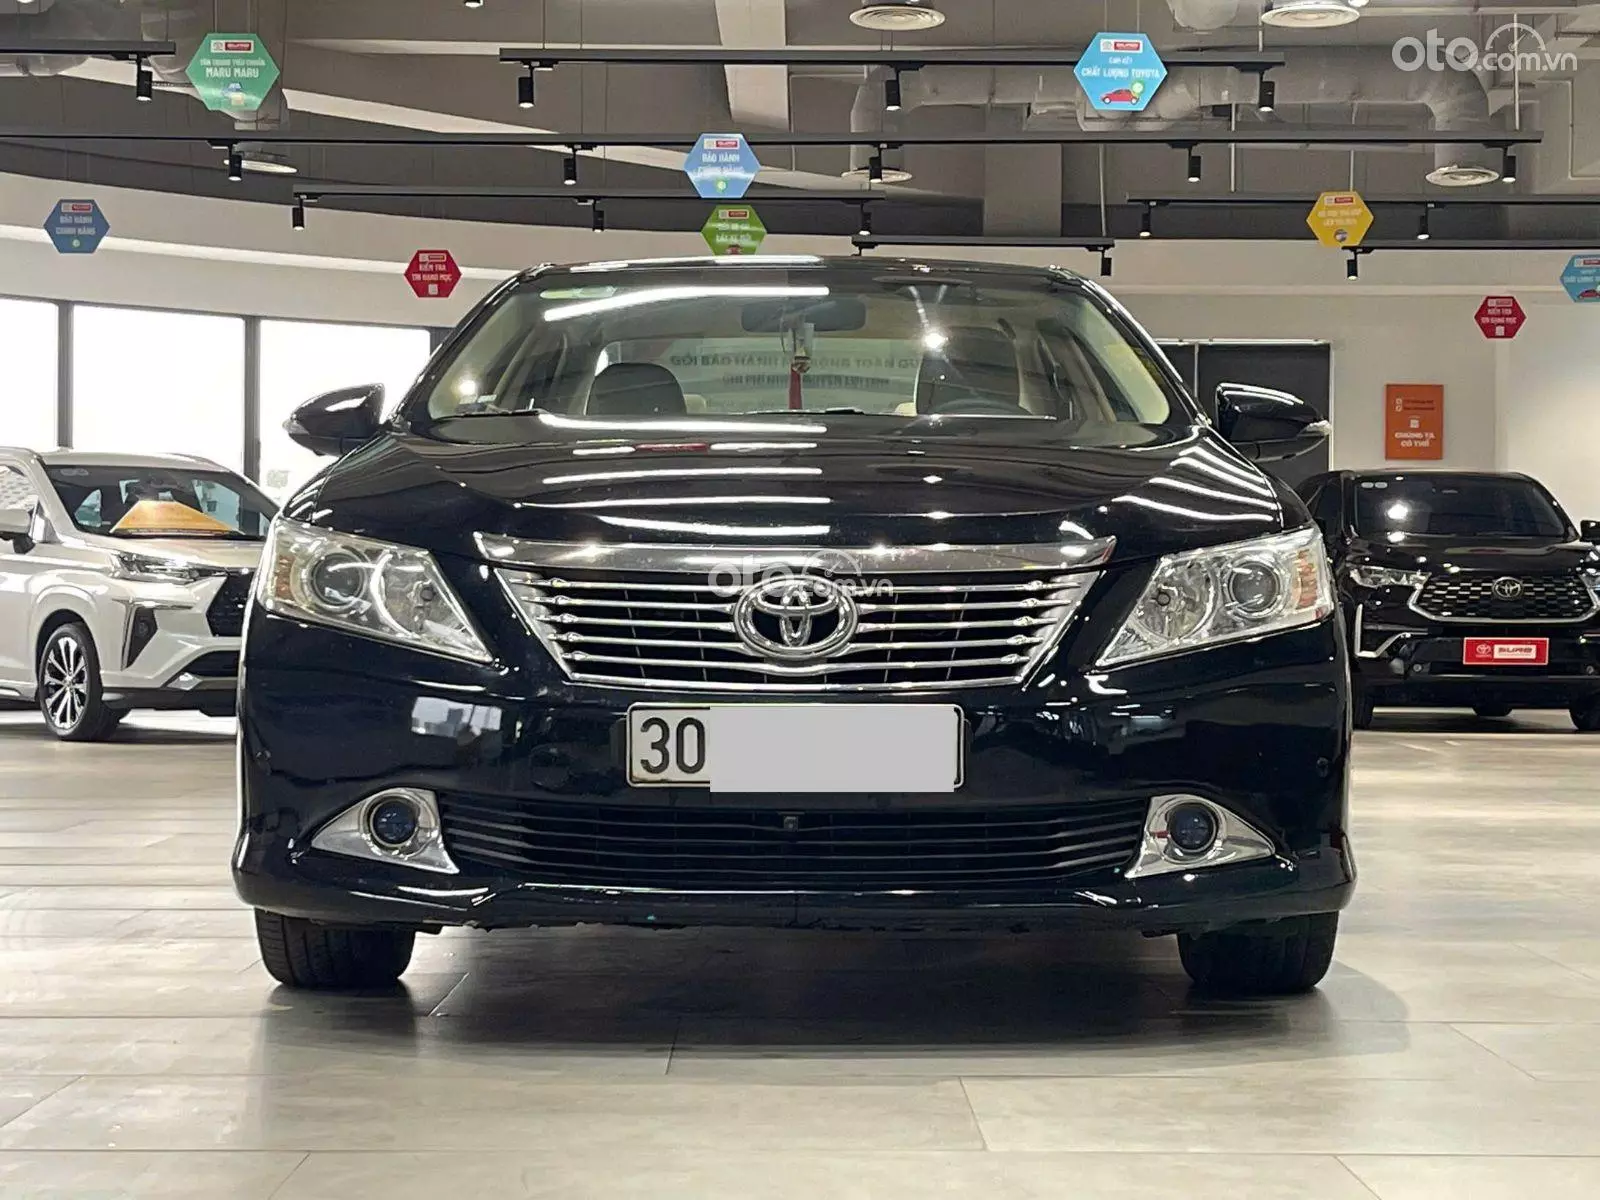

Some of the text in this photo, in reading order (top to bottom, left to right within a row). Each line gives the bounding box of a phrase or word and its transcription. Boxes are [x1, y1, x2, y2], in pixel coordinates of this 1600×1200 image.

[205, 67, 259, 78] MARU MARU
[1131, 68, 1160, 78] TOYOTA
[640, 716, 706, 775] 30
